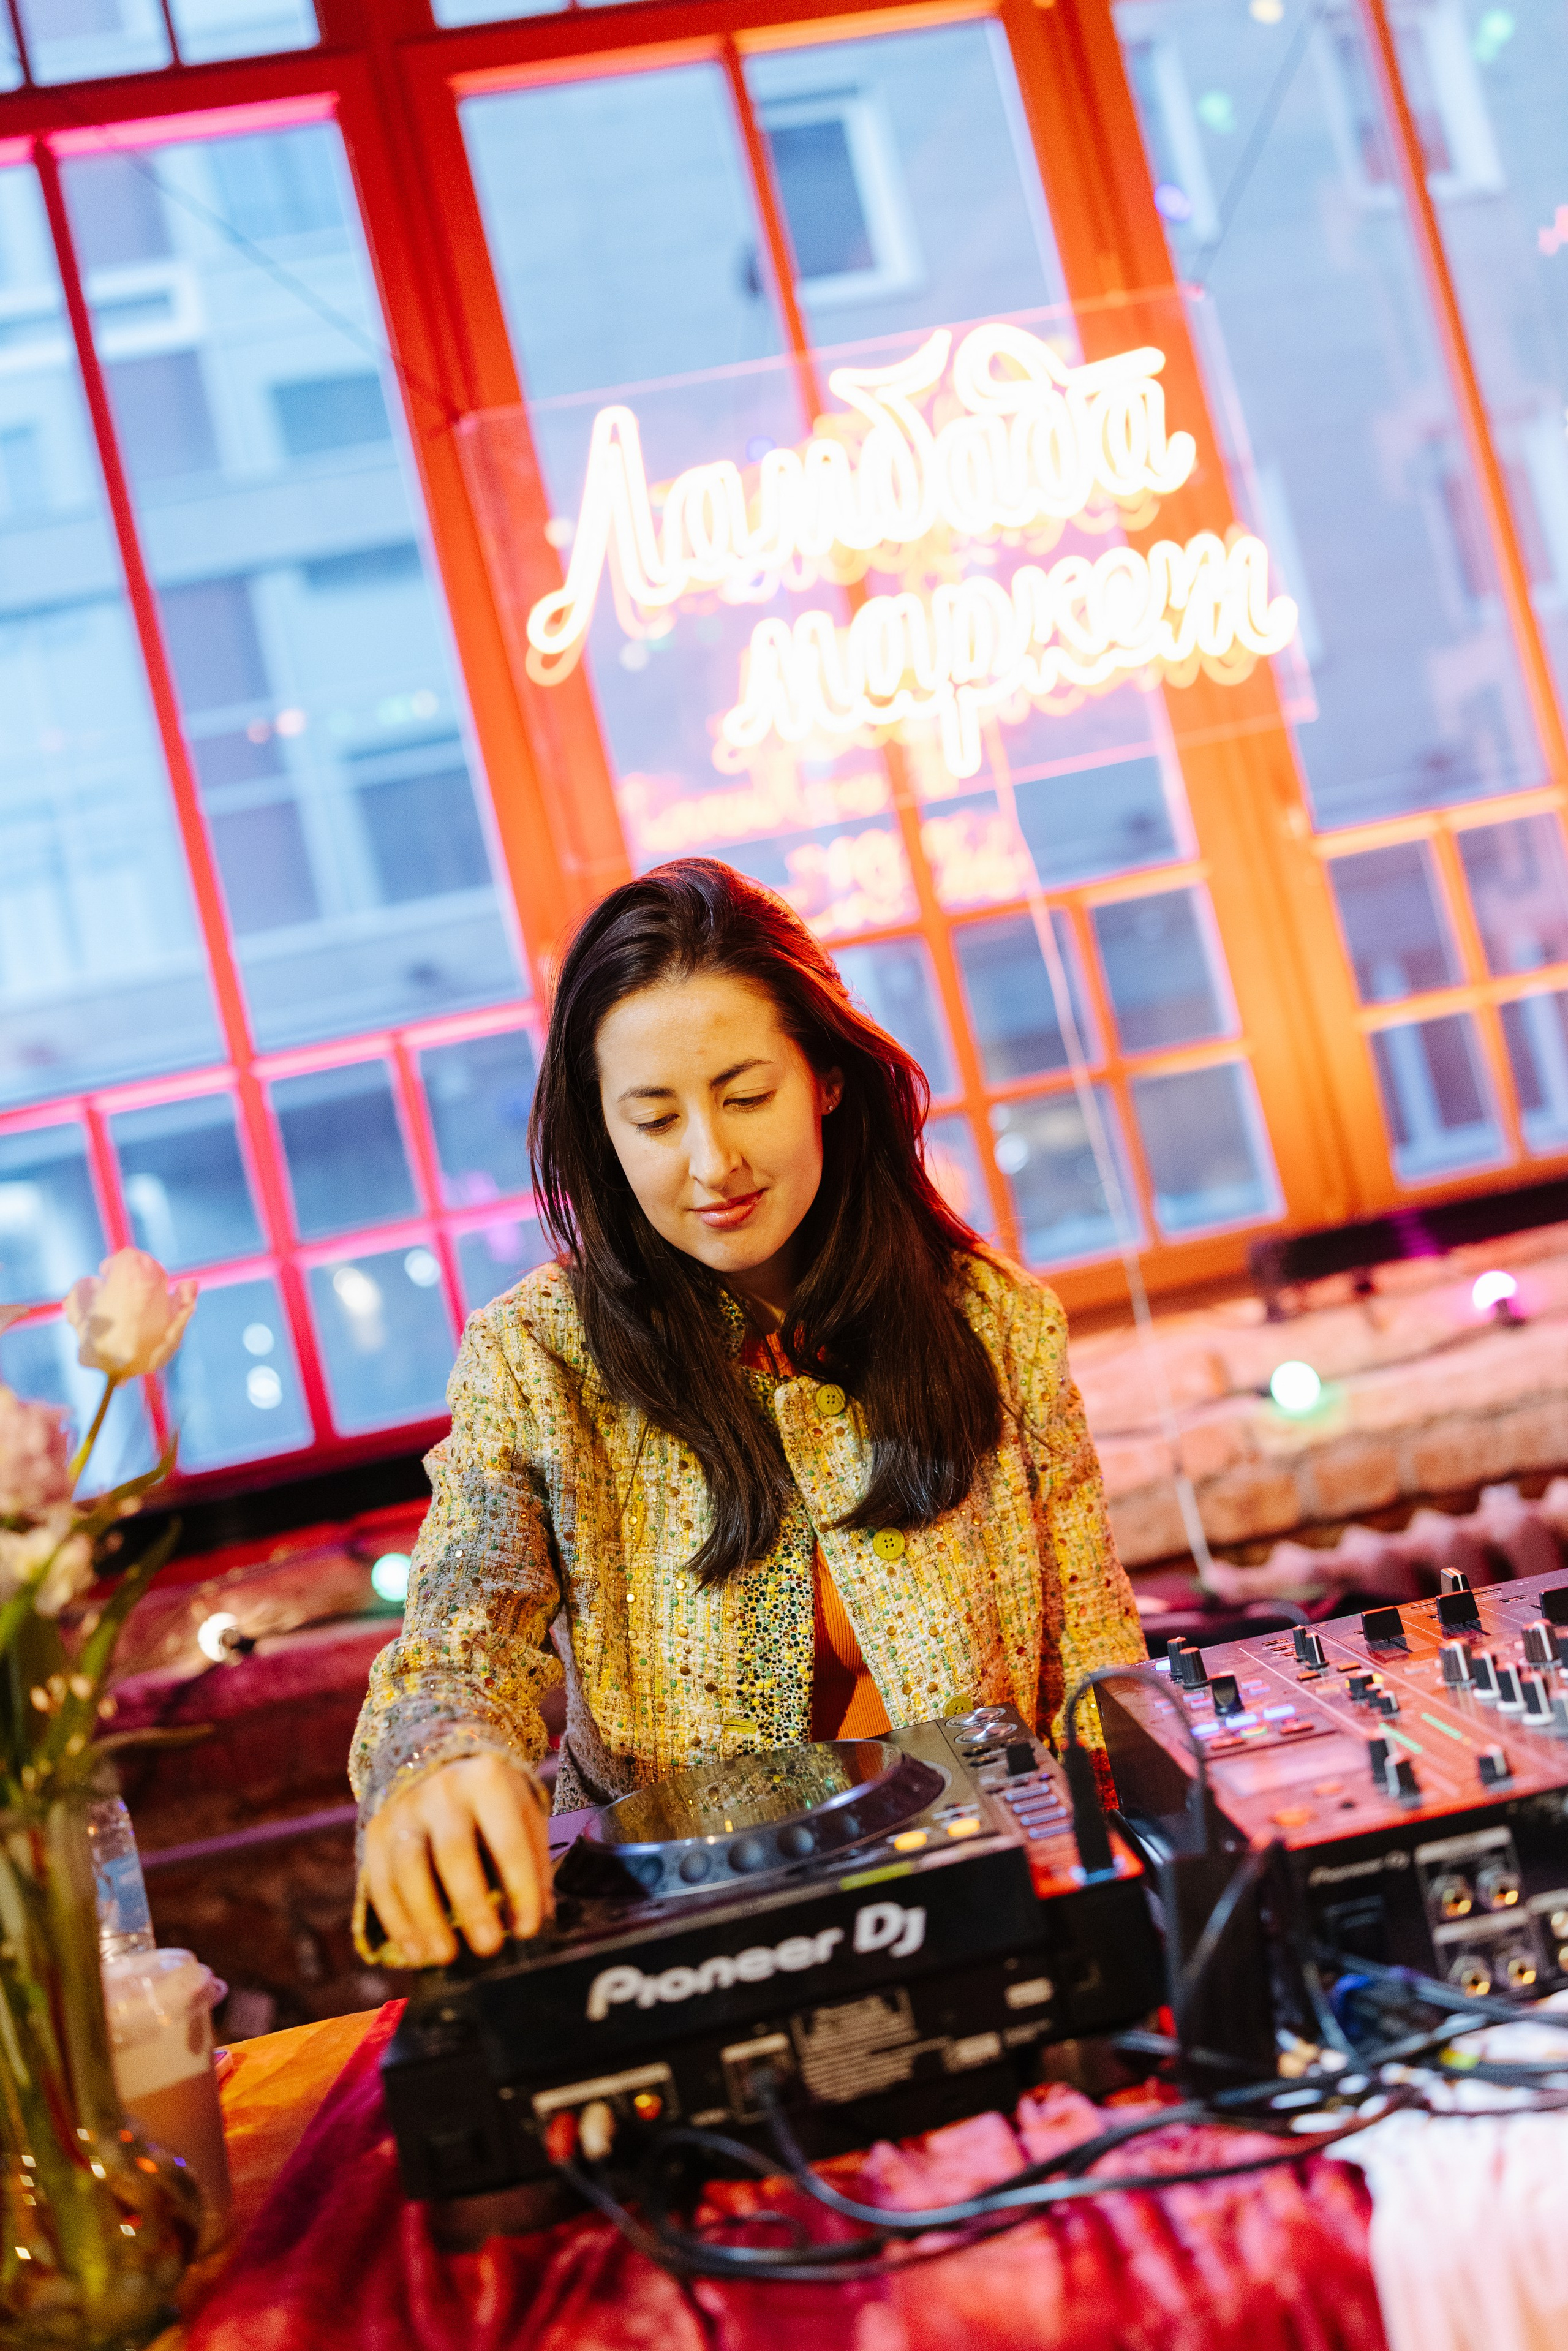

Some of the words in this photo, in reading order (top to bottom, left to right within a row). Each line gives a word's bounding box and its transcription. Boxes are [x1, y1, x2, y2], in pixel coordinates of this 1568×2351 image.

[527, 323, 1196, 654] Ламбада
[722, 531, 1299, 779] маркет
[586, 1926, 845, 2021] Pioneer
